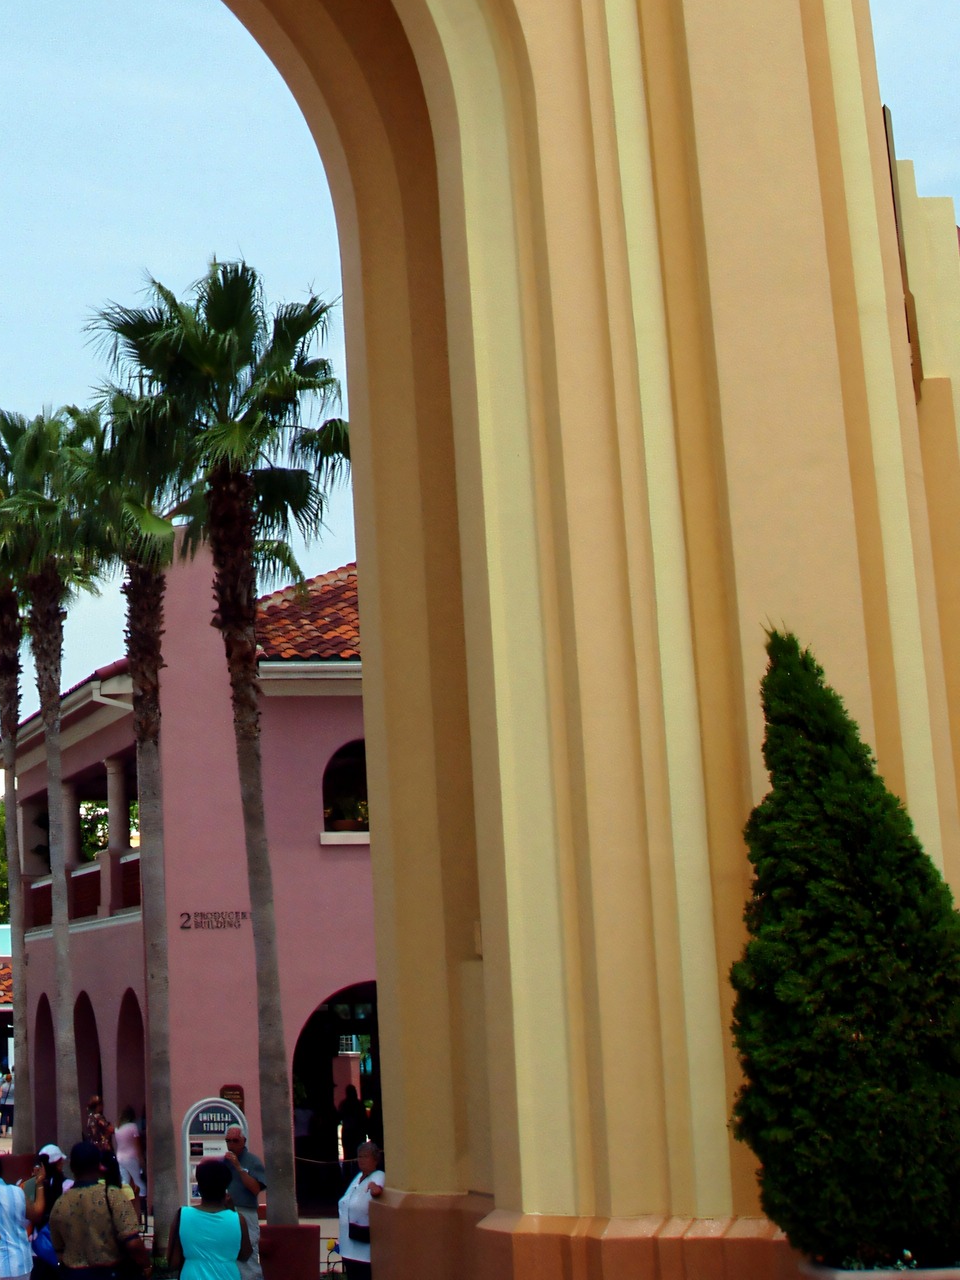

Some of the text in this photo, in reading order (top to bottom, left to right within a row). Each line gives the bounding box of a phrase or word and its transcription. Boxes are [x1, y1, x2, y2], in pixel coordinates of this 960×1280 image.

[193, 911, 251, 920] PRODUCER
[180, 912, 191, 929] 2
[193, 920, 241, 929] BUILDING
[199, 1113, 232, 1121] UNIVERSAL
